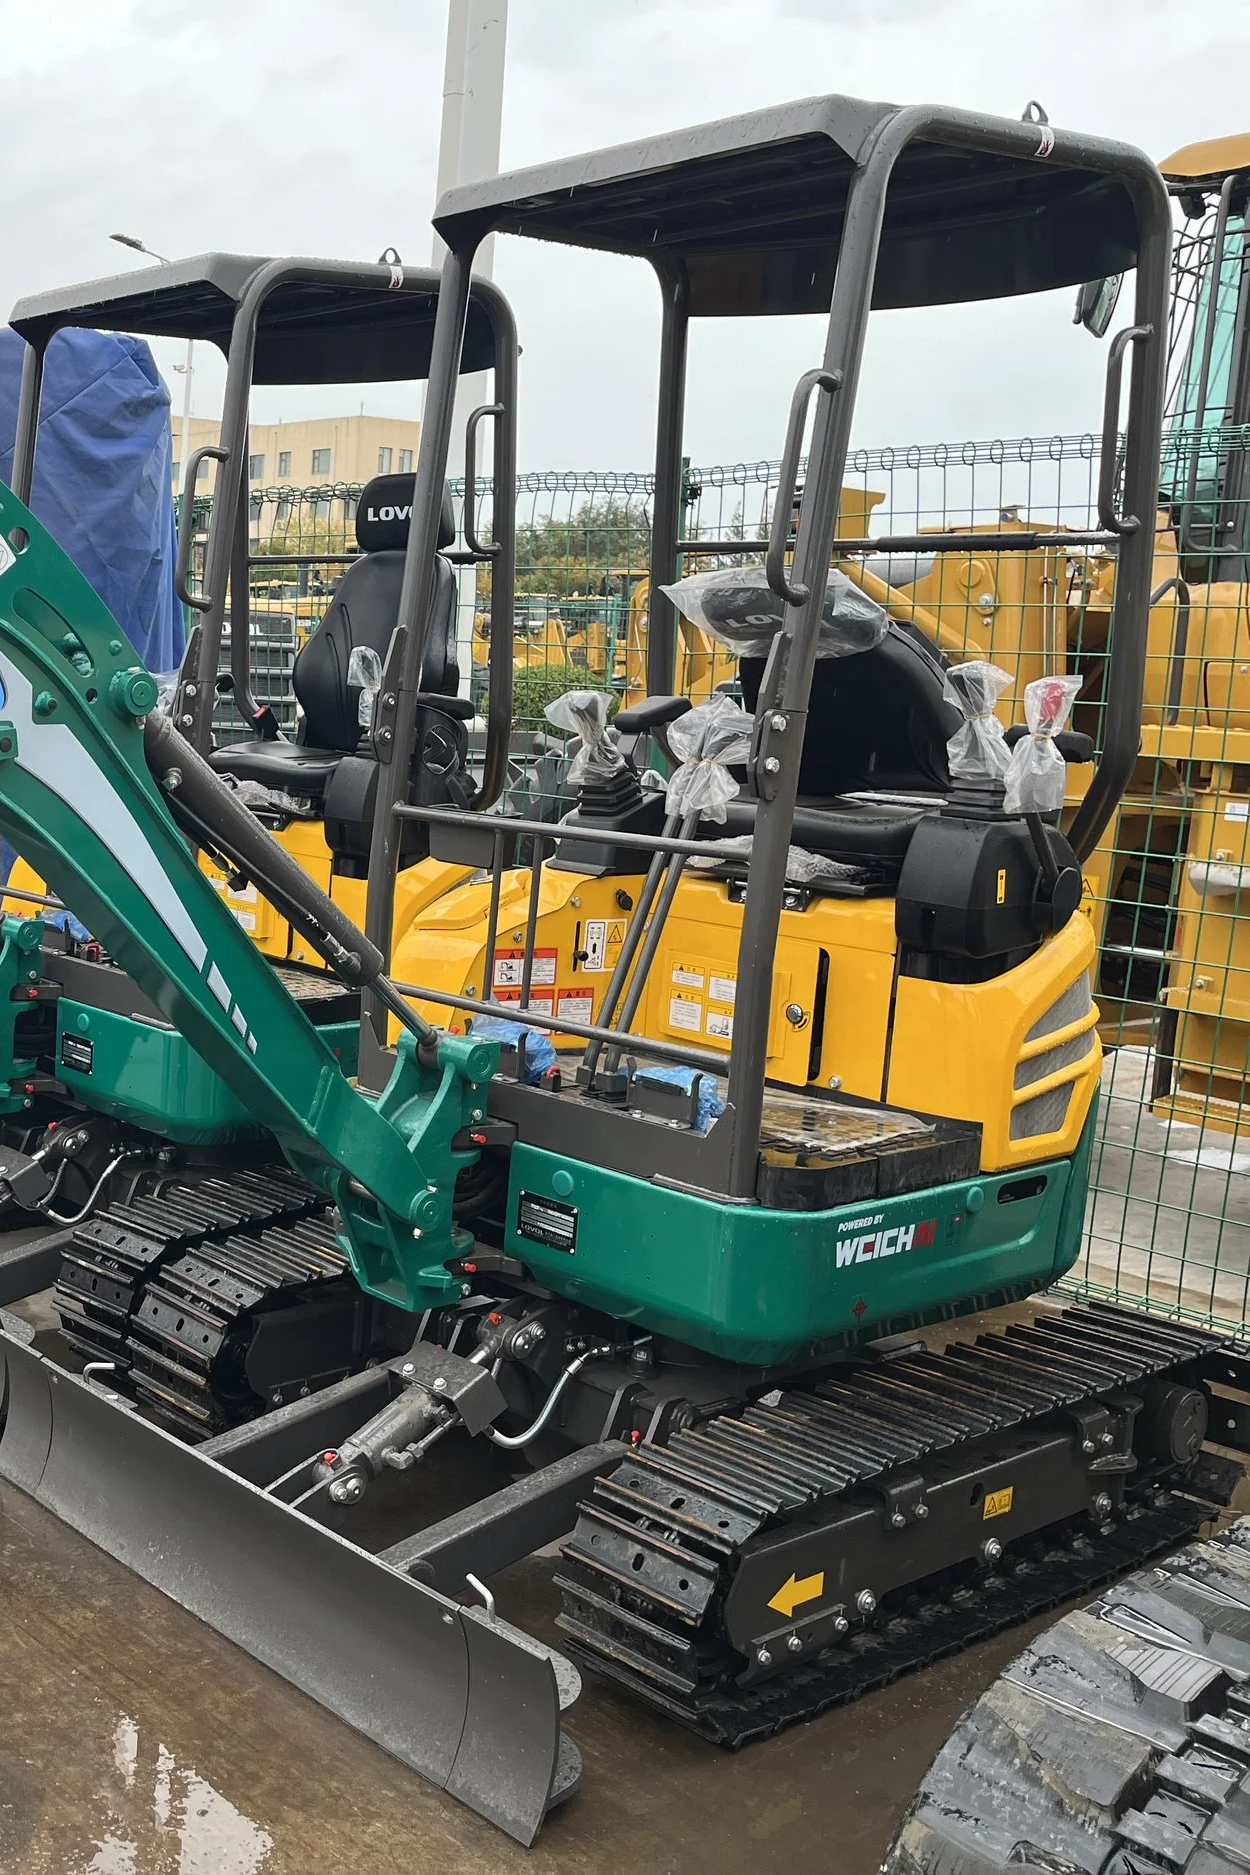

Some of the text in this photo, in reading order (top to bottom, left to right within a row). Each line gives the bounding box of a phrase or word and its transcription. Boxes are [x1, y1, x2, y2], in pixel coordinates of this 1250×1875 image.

[367, 505, 413, 521] LOV
[521, 1223, 544, 1235] LOVOL
[837, 1213, 885, 1233] POWERED BY
[835, 1219, 937, 1268] WEICHAI
